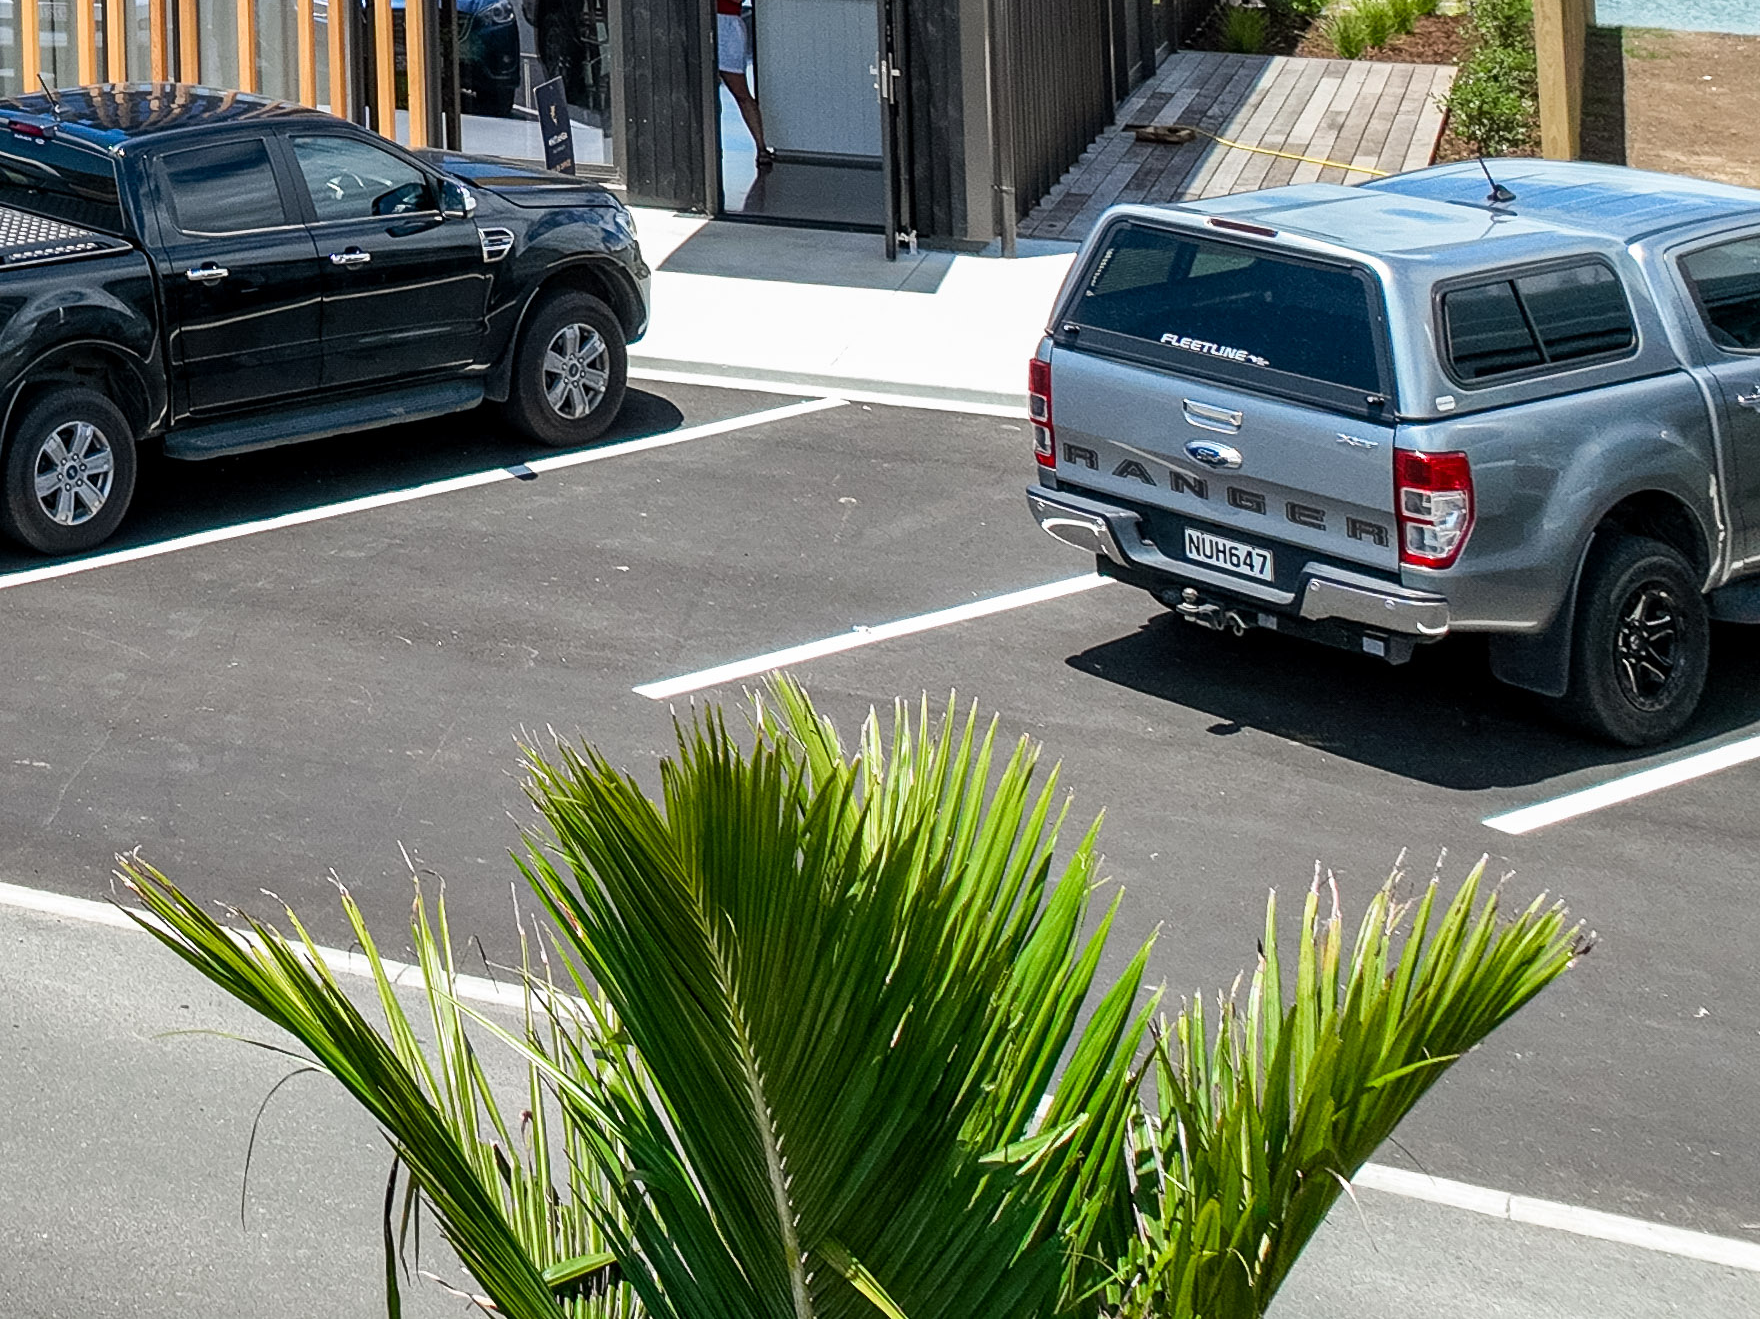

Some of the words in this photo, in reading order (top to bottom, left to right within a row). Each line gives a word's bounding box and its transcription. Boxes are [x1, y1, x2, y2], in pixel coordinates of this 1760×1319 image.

[1160, 333, 1249, 362] FLEETLINE
[1063, 442, 1390, 548] RANGER
[1187, 533, 1270, 576] NUH647
